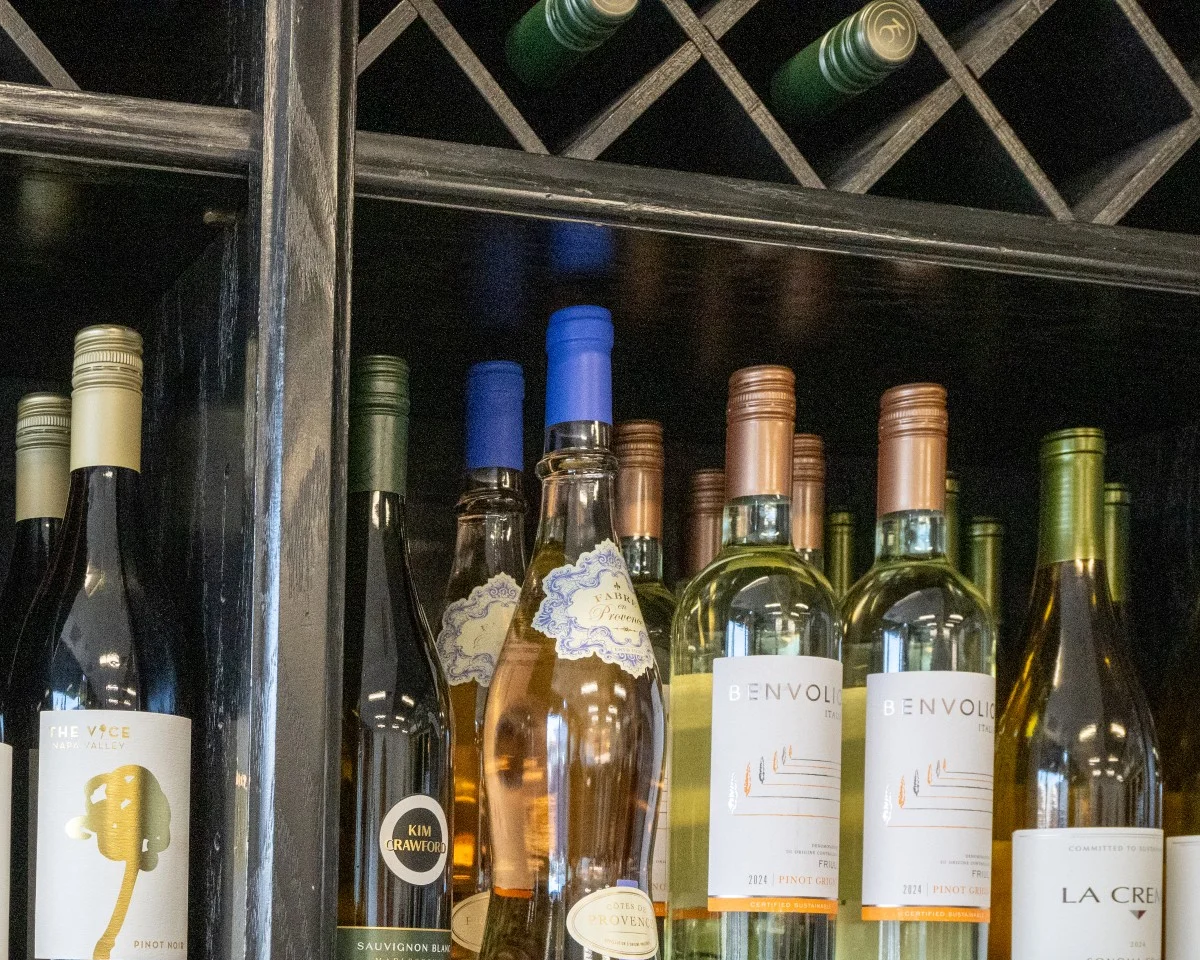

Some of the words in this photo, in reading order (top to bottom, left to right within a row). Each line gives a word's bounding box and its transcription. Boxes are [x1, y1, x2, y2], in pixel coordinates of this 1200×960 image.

[50, 726, 79, 738] THE
[408, 824, 431, 837] KIM
[385, 839, 446, 853] CRAWFORD
[748, 875, 767, 884] 2024
[779, 875, 813, 884] PINOT
[903, 884, 922, 894] 2024
[933, 885, 965, 894] PINOT
[1062, 887, 1100, 903] LA
[134, 940, 164, 949] PINOT
[357, 942, 428, 952] SAUVIGNON
